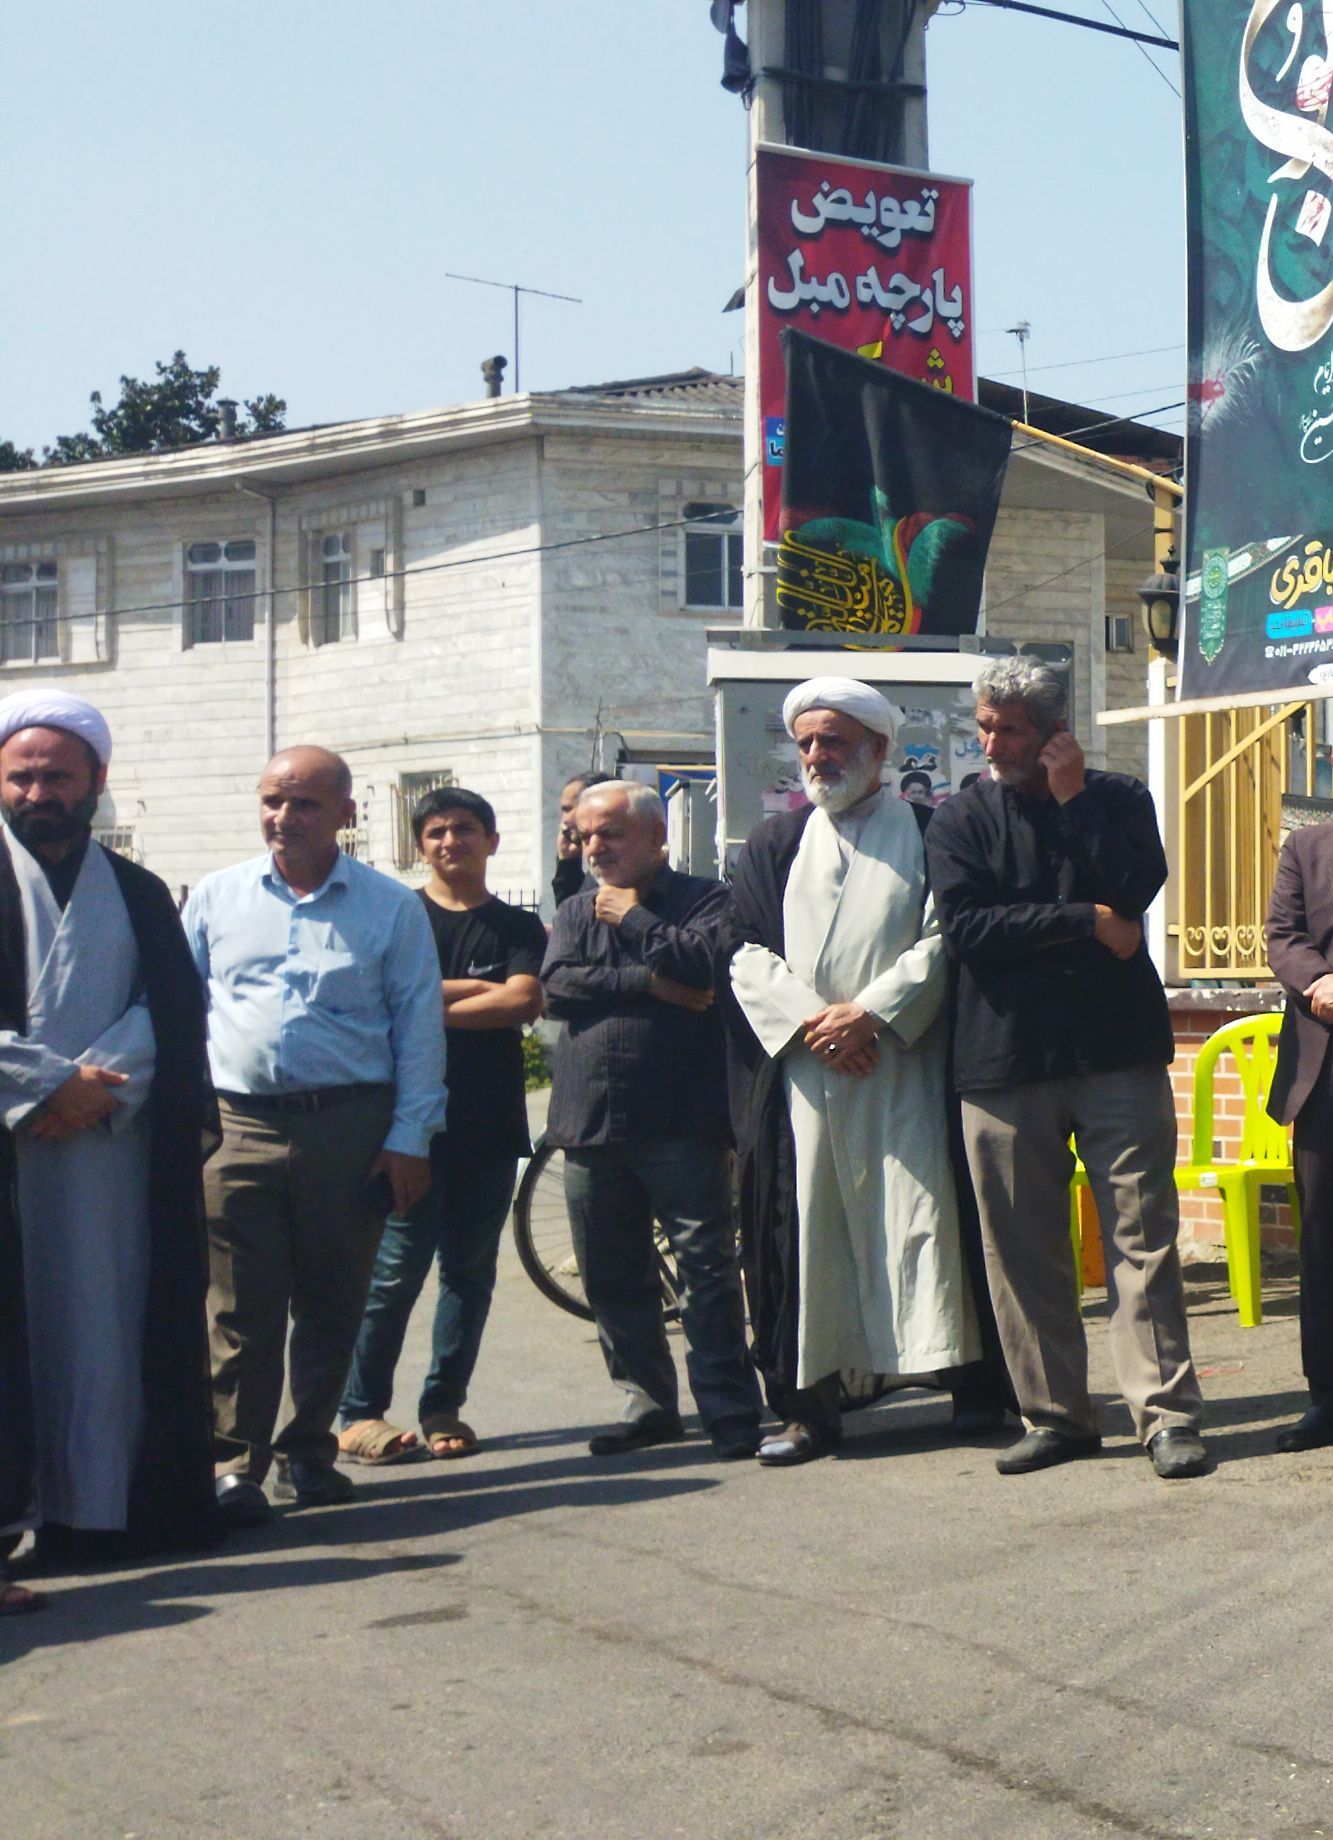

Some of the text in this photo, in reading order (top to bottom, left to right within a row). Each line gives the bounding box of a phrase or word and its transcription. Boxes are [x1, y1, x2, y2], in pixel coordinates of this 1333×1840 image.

[791, 180, 939, 248] تعویض
[768, 248, 965, 338] پارچه مبل
